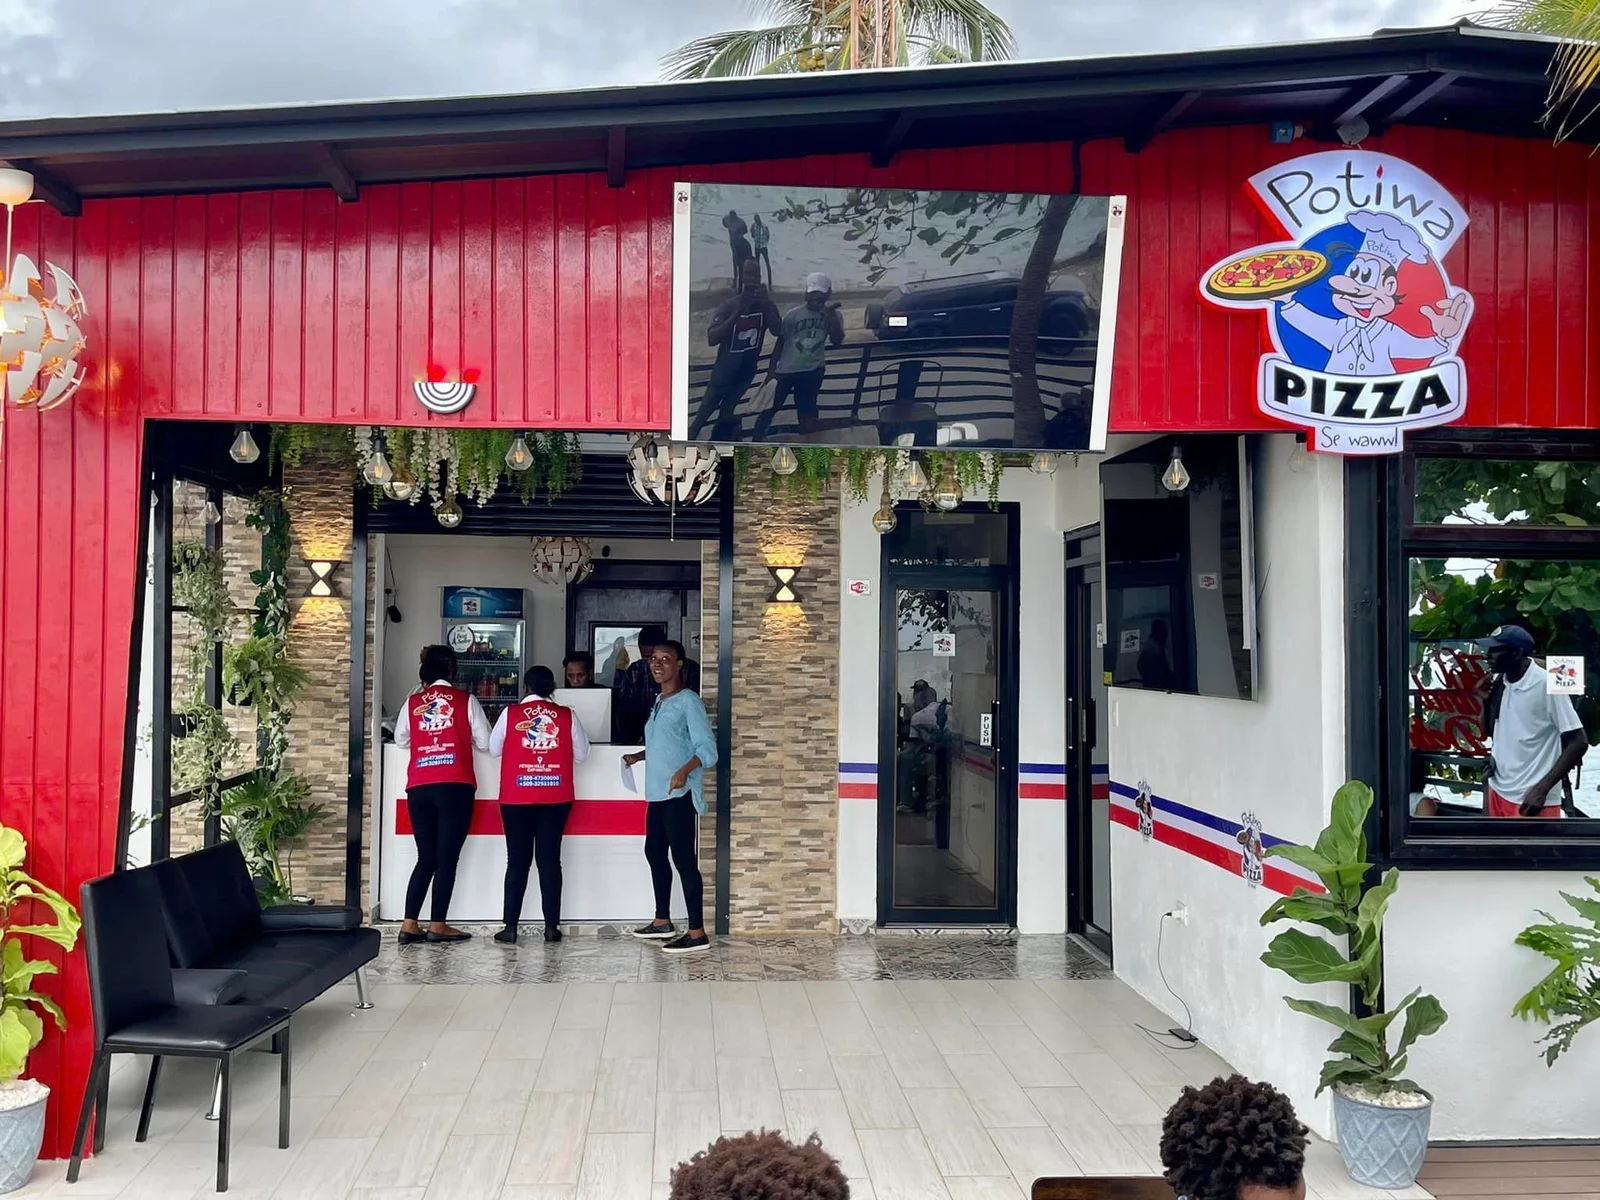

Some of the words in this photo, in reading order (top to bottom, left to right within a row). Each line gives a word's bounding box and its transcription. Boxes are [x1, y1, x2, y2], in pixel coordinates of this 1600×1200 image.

[1266, 160, 1455, 241] Potiwa
[1366, 239, 1398, 265] Potiwa
[1274, 365, 1452, 420] PIZZA
[1320, 425, 1341, 448] Se
[1348, 426, 1398, 447] waww!
[420, 719, 452, 731] PIZZA
[522, 738, 558, 750] PIZZA
[1242, 862, 1262, 881] PIZZA
